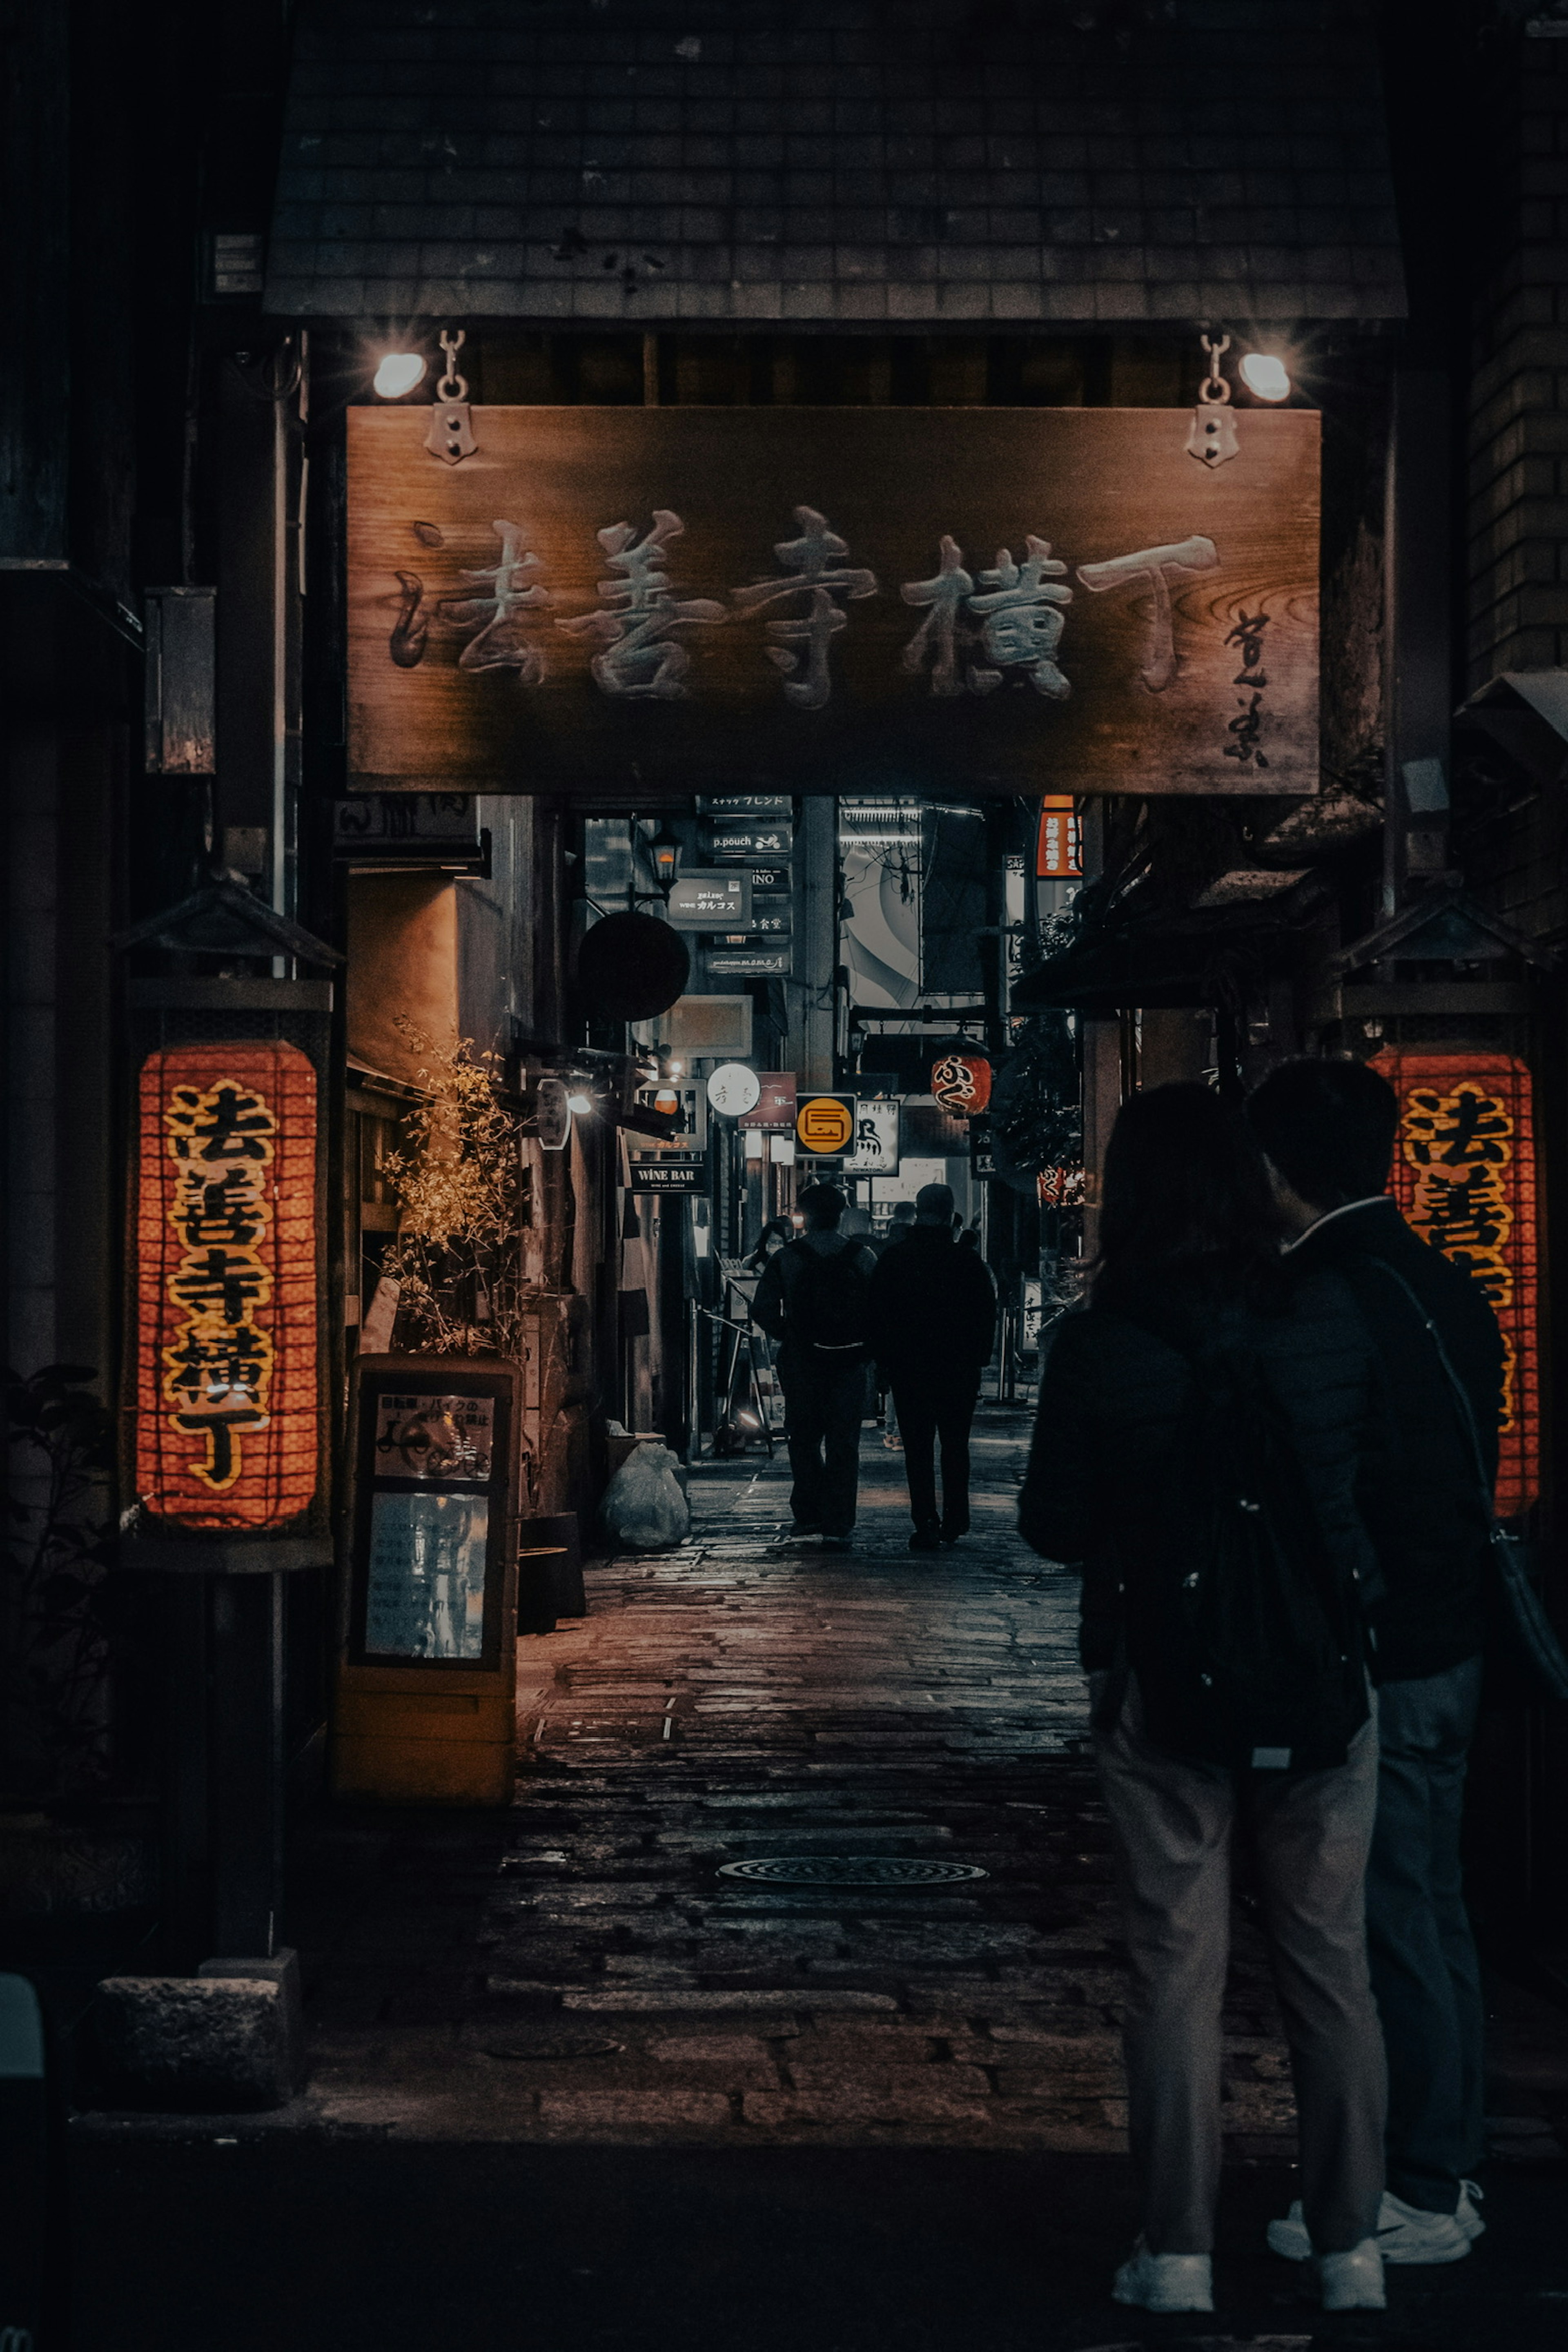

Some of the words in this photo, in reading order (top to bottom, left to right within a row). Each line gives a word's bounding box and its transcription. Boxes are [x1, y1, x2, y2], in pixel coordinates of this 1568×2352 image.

[388, 506, 1221, 710] 法善寺横丁
[744, 796, 783, 805] フレンド
[713, 836, 751, 848] p.pouch
[697, 901, 735, 910] カルコス
[670, 1170, 695, 1181] BAR
[167, 1081, 279, 1488] 法善寺横丁
